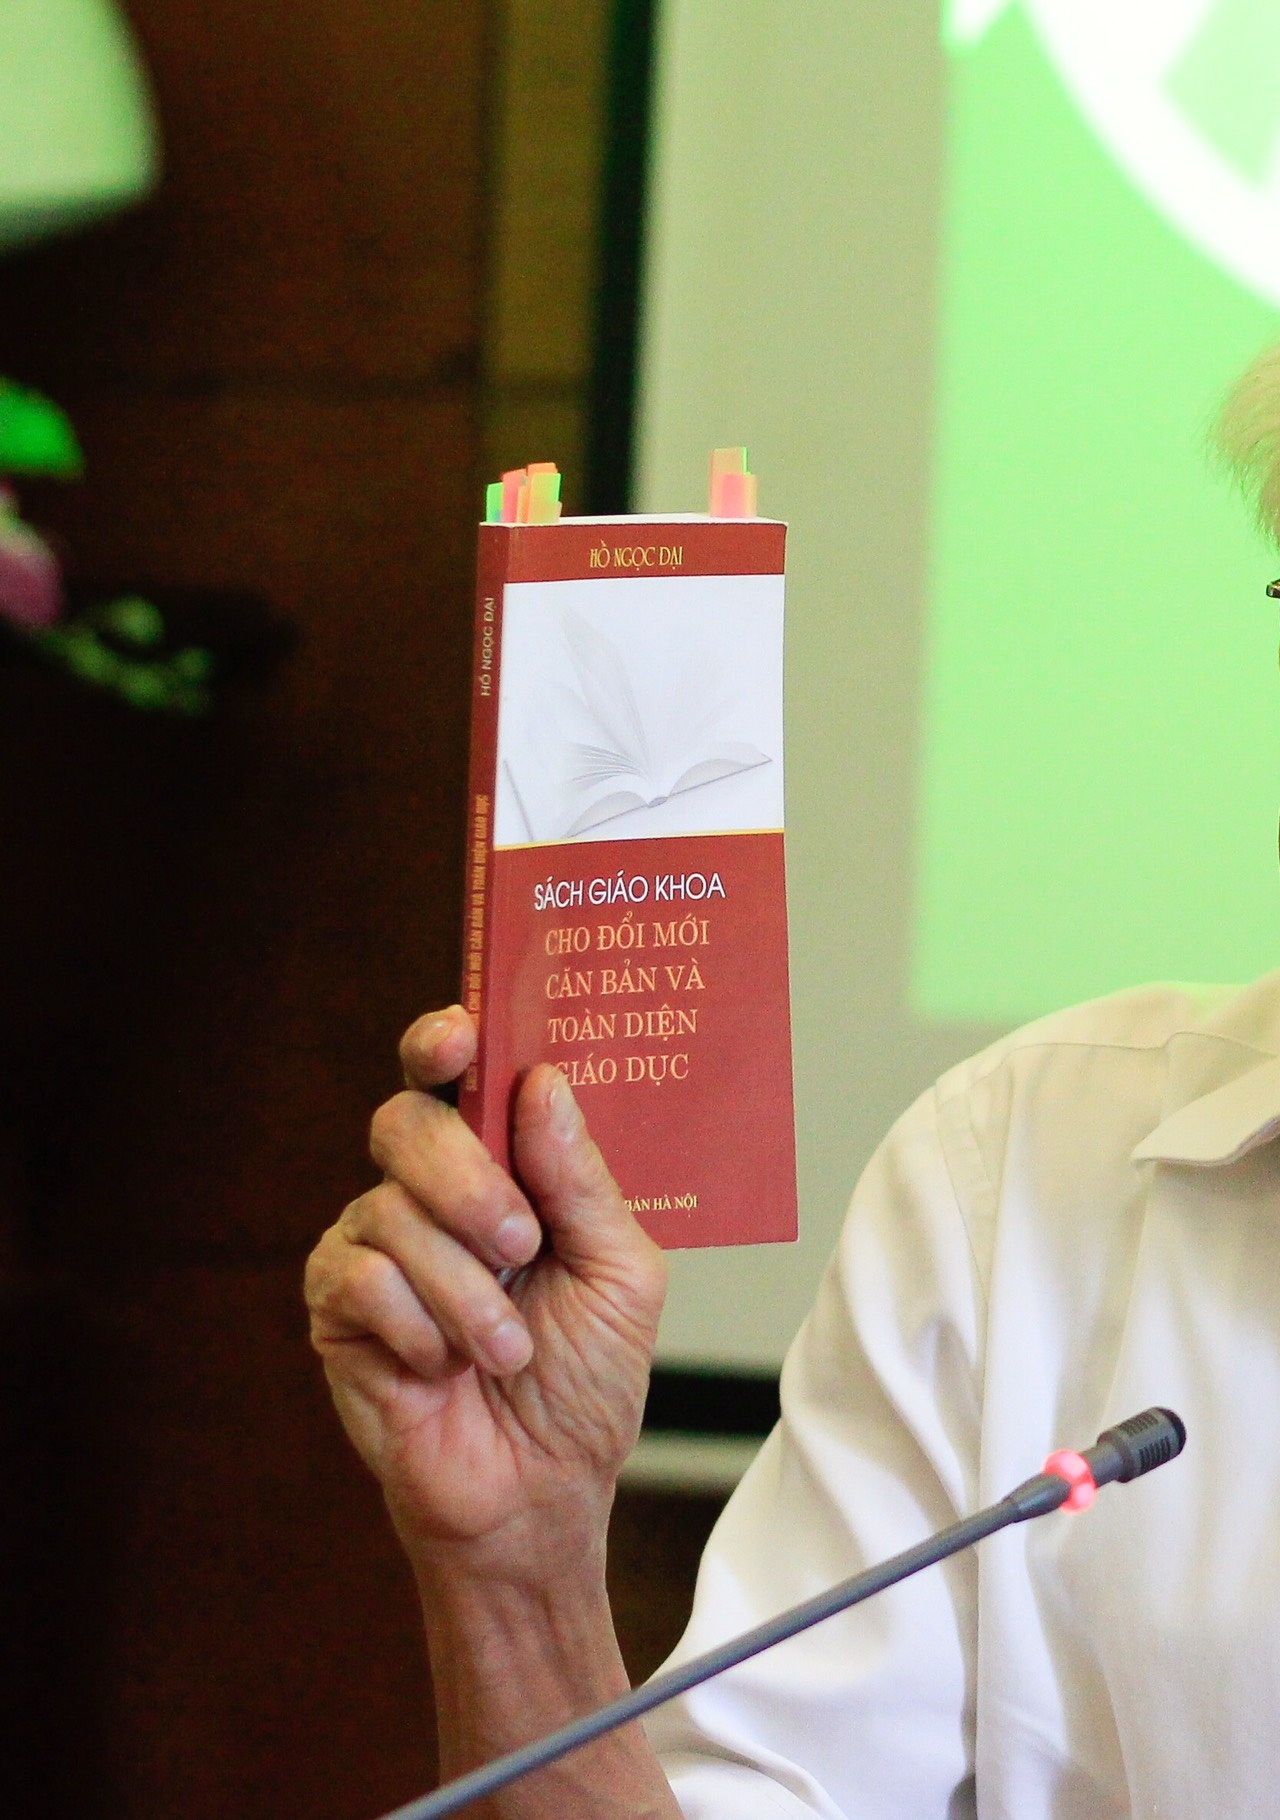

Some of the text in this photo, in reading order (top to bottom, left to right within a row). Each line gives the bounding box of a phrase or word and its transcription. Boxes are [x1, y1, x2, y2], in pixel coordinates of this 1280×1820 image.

[590, 539, 610, 568] HỒ
[614, 546, 656, 571] NGỌC
[534, 870, 727, 910] SÁCH GIÁO KHOA
[545, 911, 710, 955] CHO ĐỔI MỚI
[545, 957, 706, 1000] CĂN BẢN VÀ
[547, 1004, 698, 1044] TOÀN DIỆN
[625, 1054, 689, 1086] DỤC
[653, 1193, 672, 1210] HÀ
[674, 1192, 698, 1212] NỘI
